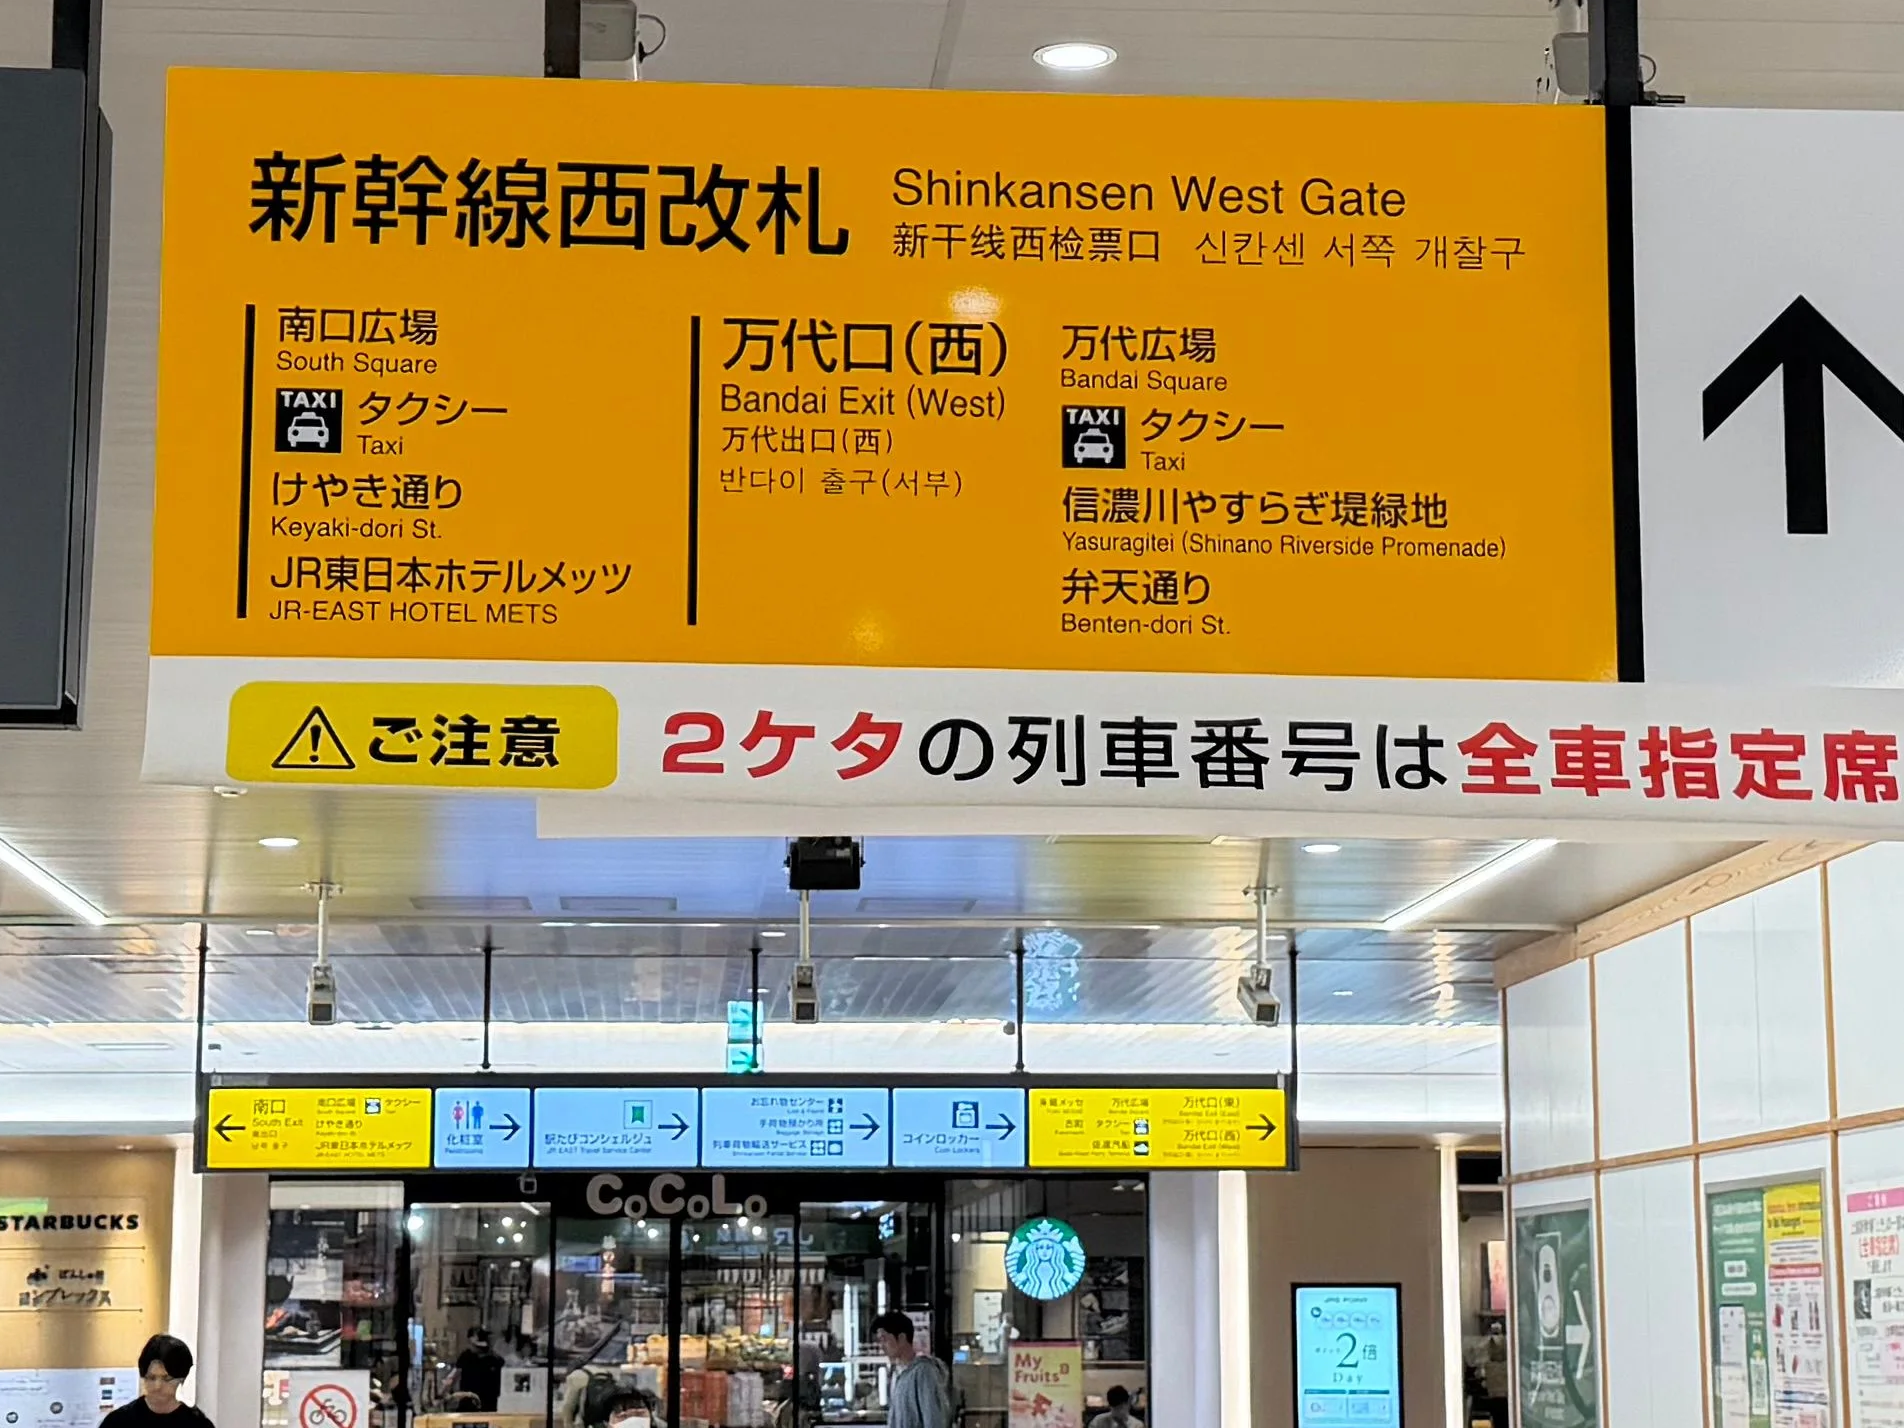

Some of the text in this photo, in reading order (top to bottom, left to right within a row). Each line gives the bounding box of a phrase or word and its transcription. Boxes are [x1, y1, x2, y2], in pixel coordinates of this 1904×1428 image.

[249, 151, 849, 255] 新幹線西改札
[893, 168, 1405, 217] Shinkansen West Gate
[893, 222, 1159, 262] 新干线西检票口
[1196, 230, 1525, 270] 신칸센 서쪽 개찰구
[278, 306, 438, 345] 南口広場
[1062, 325, 1216, 363] 万代広場
[277, 350, 437, 377] South Square
[1061, 369, 1227, 395] Bandai Square
[281, 391, 336, 409] TAXI
[359, 391, 507, 426] タクシー
[722, 384, 1004, 420] Bandai Exit (West)
[1067, 408, 1120, 425] TAXI
[1141, 408, 1284, 442] タクシー
[357, 435, 403, 455] Taxi
[1141, 452, 1184, 470] Taxi
[273, 472, 461, 509] けやき通り
[721, 466, 961, 497] 반다이 출구(서부)
[1063, 486, 1447, 528] 信濃川やすらぎ堤緑地
[272, 516, 441, 541] Keyaki-dori St.
[1063, 531, 1505, 559] Yasuragitei (Shinano Riverside Promenade)
[271, 555, 631, 594] JR東日本ホテルメッツ
[1062, 568, 1209, 605] 弁天通り
[270, 600, 557, 624] JR-EAST HOTEL METS
[1062, 613, 1230, 634] Benten-dori St.
[368, 714, 561, 769] ご注意
[253, 1099, 286, 1115] 南口
[385, 1098, 421, 1107] タクシー
[252, 1118, 303, 1127] South Exit
[447, 1133, 484, 1146] 化粧室
[544, 1132, 652, 1146] 駅たびコンシェルジュ
[903, 1133, 980, 1145] コインロッカー
[586, 1173, 767, 1219] CoCoLo
[1015, 1353, 1042, 1371] My
[1015, 1369, 1060, 1383] Fruits
[1332, 1372, 1363, 1385] Day
